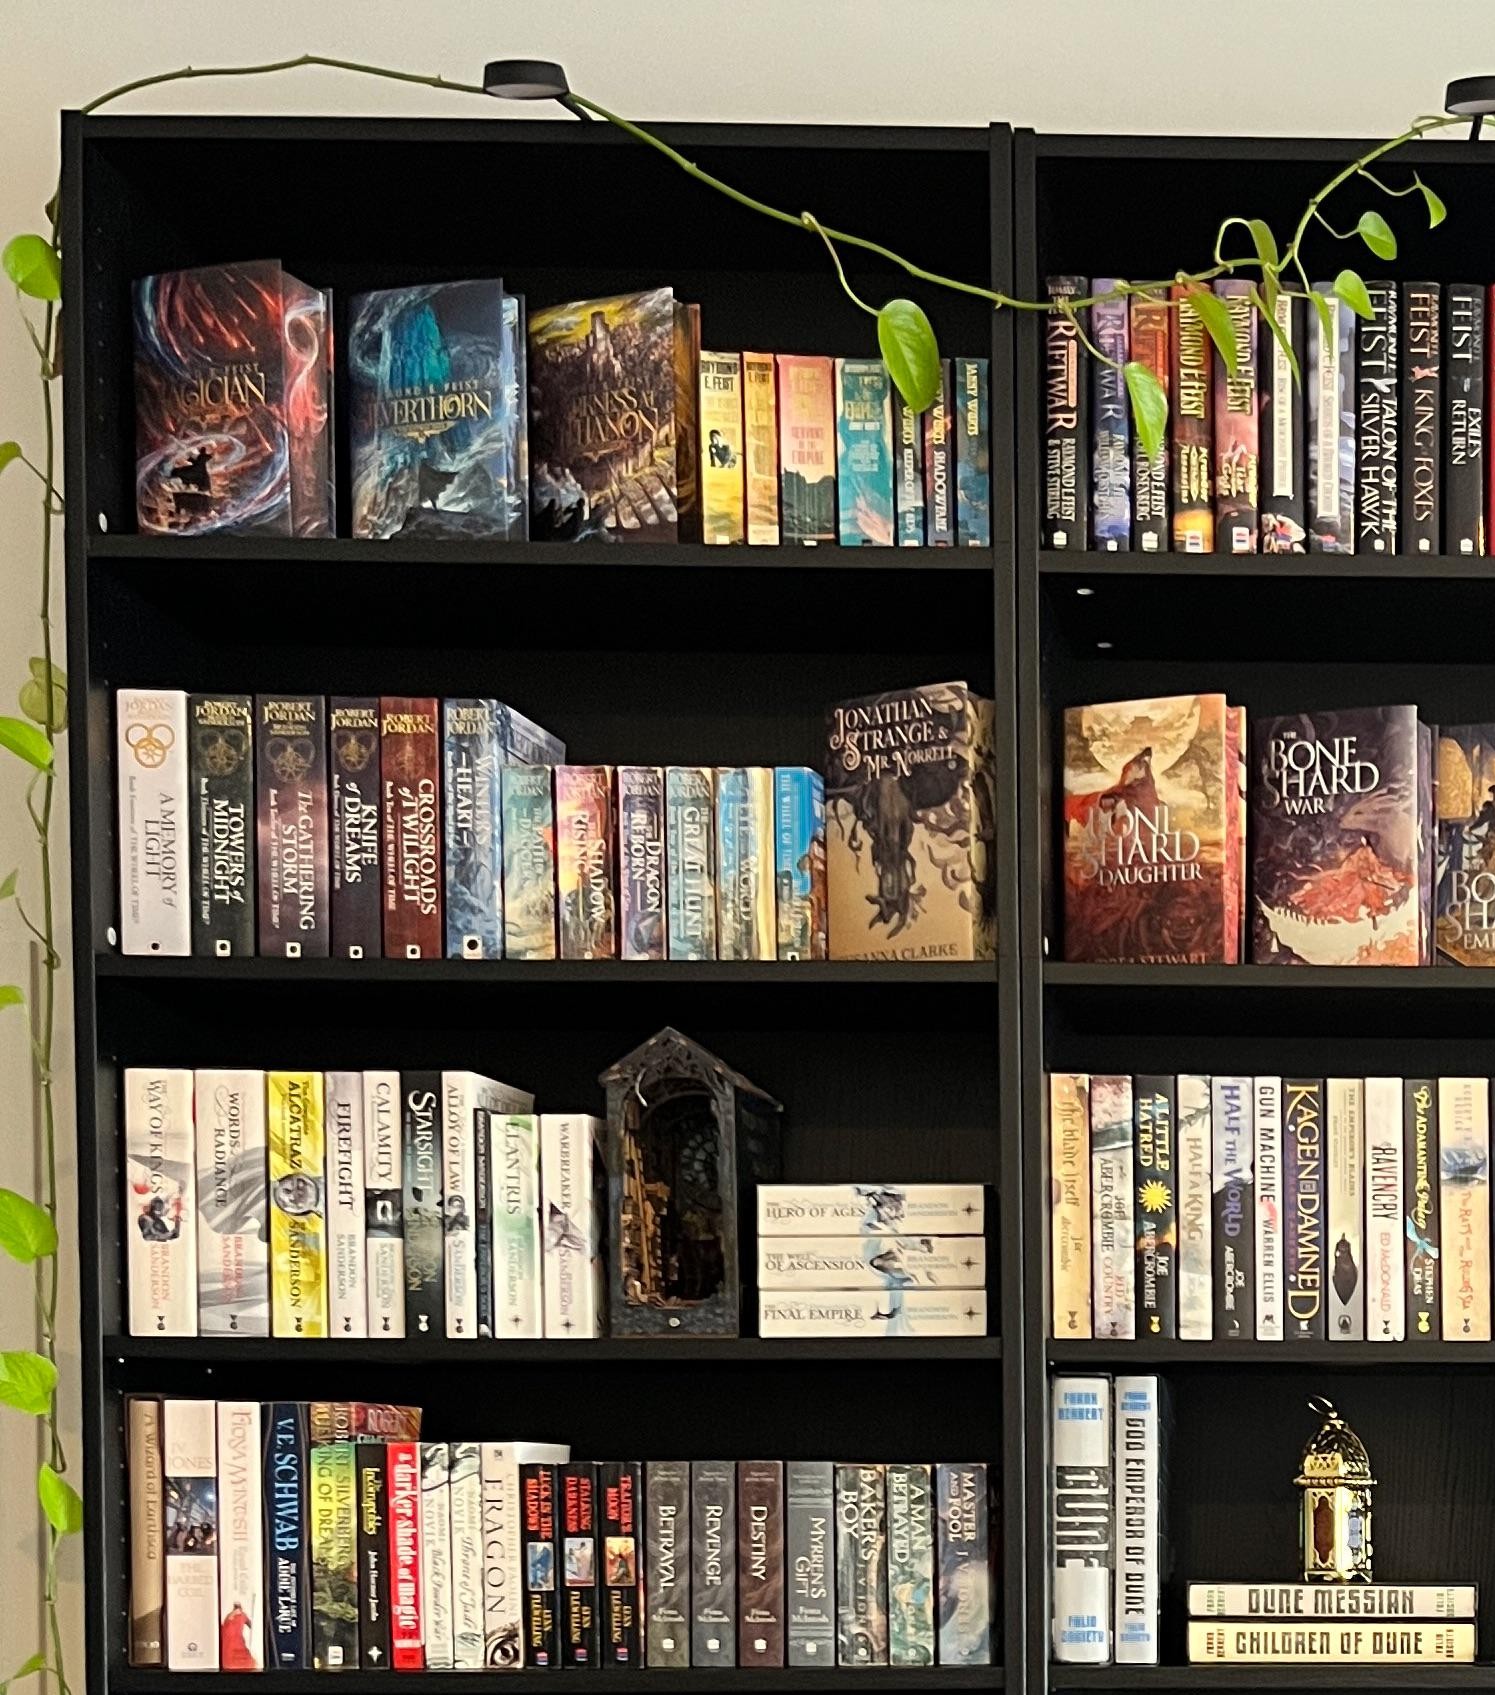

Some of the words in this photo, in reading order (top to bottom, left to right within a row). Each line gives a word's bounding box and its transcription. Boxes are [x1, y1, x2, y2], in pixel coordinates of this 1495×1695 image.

[1047, 320, 1076, 429] RIFTWAR
[1362, 393, 1379, 460] SILVER
[1362, 467, 1379, 538] HAWK
[830, 698, 933, 751] JONATHAN
[844, 721, 934, 771] STRANGE
[895, 745, 955, 780] NORRELL
[1270, 737, 1356, 773] BONE
[1263, 762, 1379, 808] SHARD
[1285, 798, 1325, 815] WAR
[214, 799, 230, 904] MIDNIGHT
[419, 779, 436, 915] CROSSROADS
[646, 842, 661, 914] DRAGON
[1100, 863, 1202, 886] DAUGHTER
[288, 1081, 303, 1169] ALCATRAZ
[1260, 1086, 1274, 1118] GUN
[337, 1103, 354, 1210] FIREFIGHT
[1140, 1099, 1153, 1167] HATRED
[1260, 1128, 1275, 1203] MACHINE
[766, 1208, 805, 1218] HERO
[810, 1208, 826, 1217] OF
[833, 1208, 864, 1217] AGES
[1263, 1219, 1274, 1267] WARREN
[1263, 1271, 1274, 1303] ELLIS
[764, 1309, 800, 1319] FINAL
[810, 1309, 863, 1320] EMPIRE
[1126, 1419, 1145, 1450] GOD
[274, 1450, 298, 1551] SCHWAB
[1126, 1459, 1145, 1539] EMPEROR
[485, 1479, 504, 1615] ERAGON
[659, 1506, 675, 1591] BETRAYAL
[751, 1506, 767, 1581] DESTINY
[1126, 1547, 1145, 1566] OF
[1126, 1572, 1145, 1615] DUNE
[1248, 1589, 1303, 1614] DUNE
[1314, 1589, 1414, 1614] MESSIAH
[1236, 1632, 1329, 1654] CHILDREN
[1341, 1632, 1363, 1654] OF
[1372, 1632, 1422, 1654] DUNE
